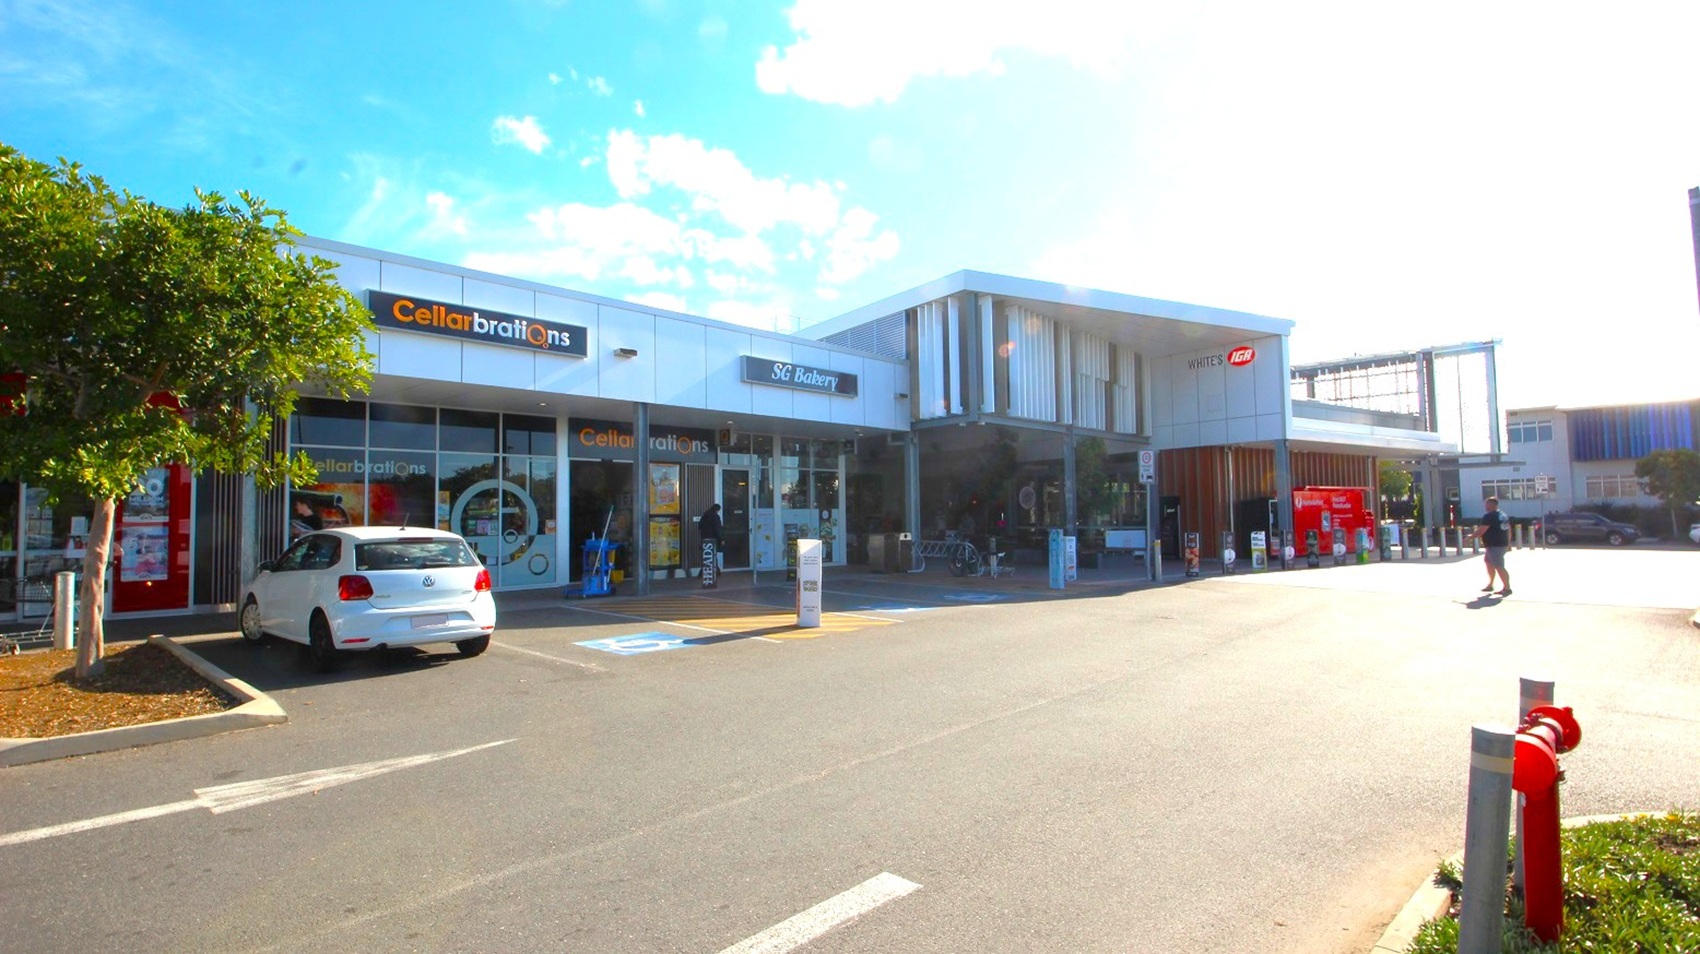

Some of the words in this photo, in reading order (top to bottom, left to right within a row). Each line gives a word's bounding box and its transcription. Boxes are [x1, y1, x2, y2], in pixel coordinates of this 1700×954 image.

[1188, 354, 1223, 370] WHITE'S
[1230, 349, 1252, 363] IGA
[772, 363, 792, 381] SG
[794, 367, 838, 391] Bakery
[308, 458, 427, 476] ellarbrations
